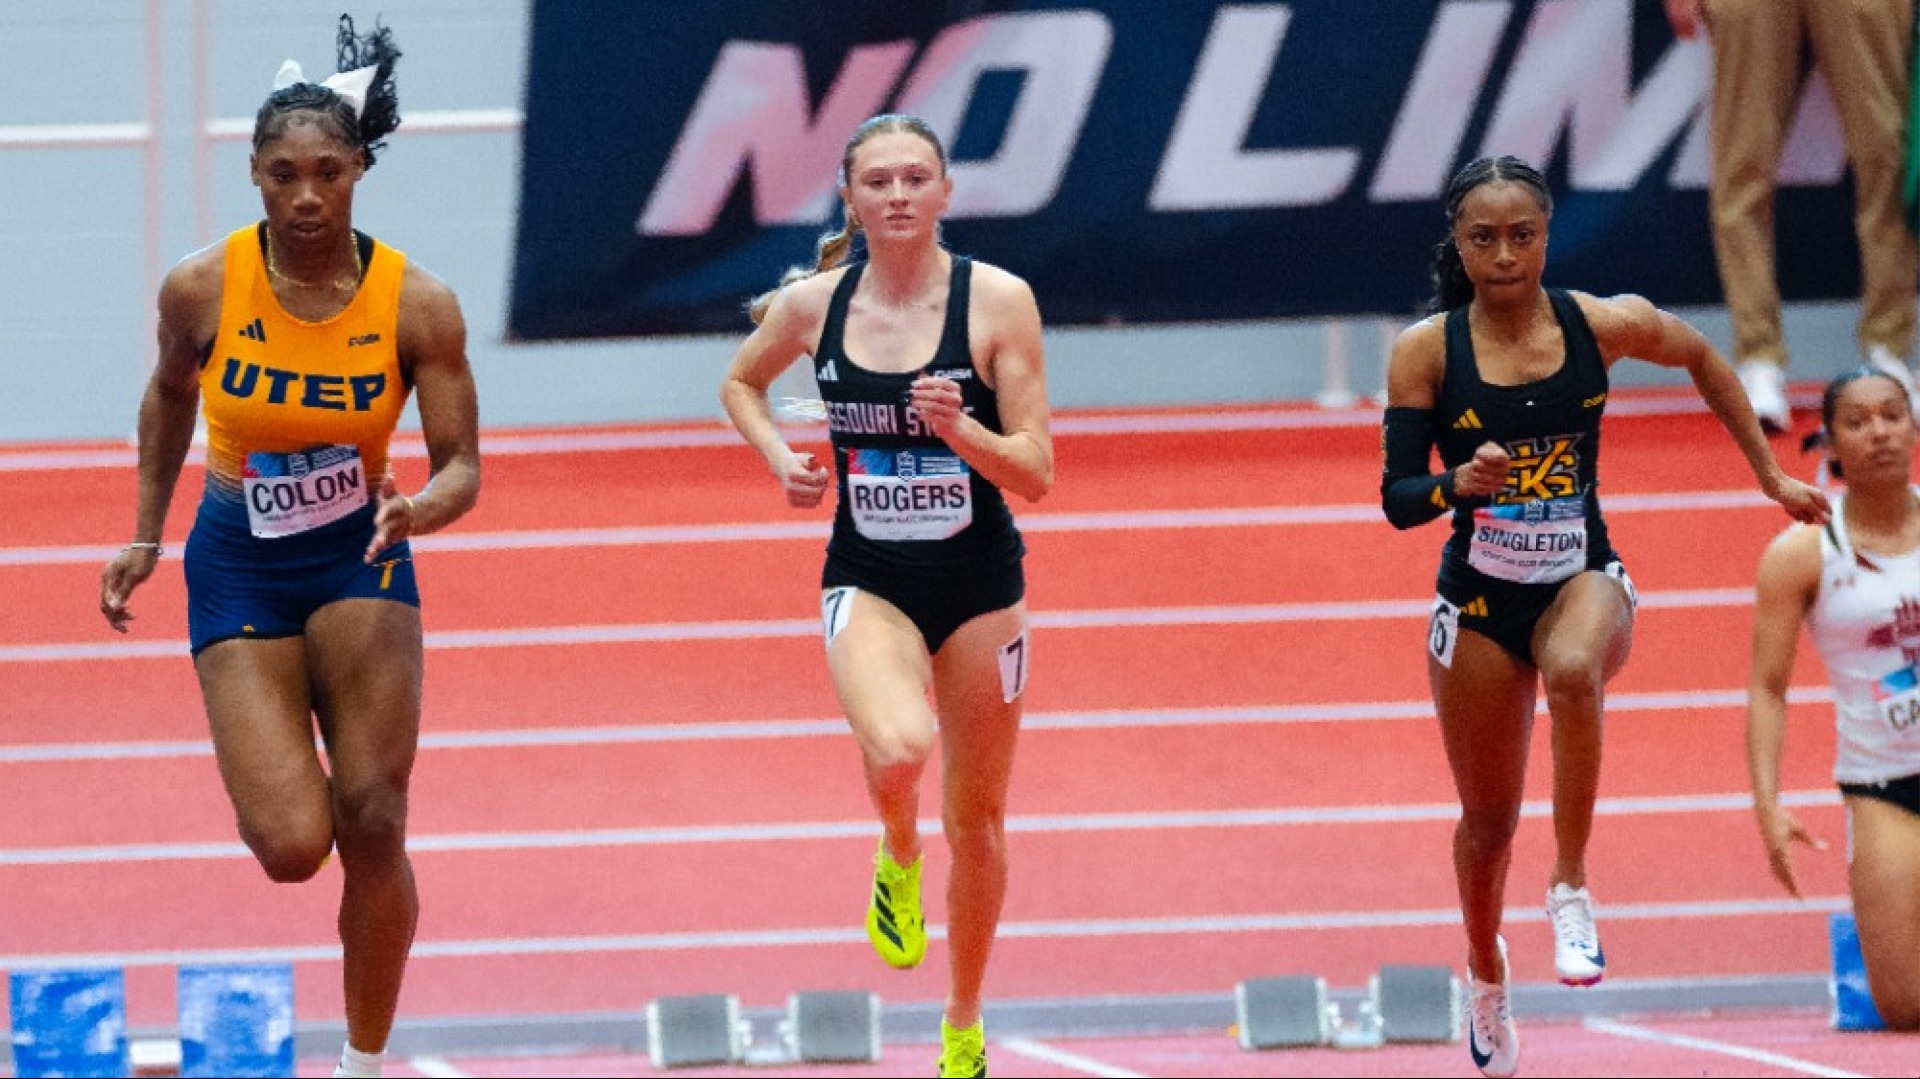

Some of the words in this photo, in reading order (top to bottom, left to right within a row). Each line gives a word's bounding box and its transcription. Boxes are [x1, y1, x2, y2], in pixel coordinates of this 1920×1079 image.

[636, 8, 1113, 236] NO
[221, 357, 386, 411] UTEP
[252, 466, 360, 513] COLON
[855, 483, 965, 511] ROGERS
[1478, 526, 1583, 552] SINGLETON
[825, 589, 846, 640] 7
[1006, 635, 1024, 693] 7
